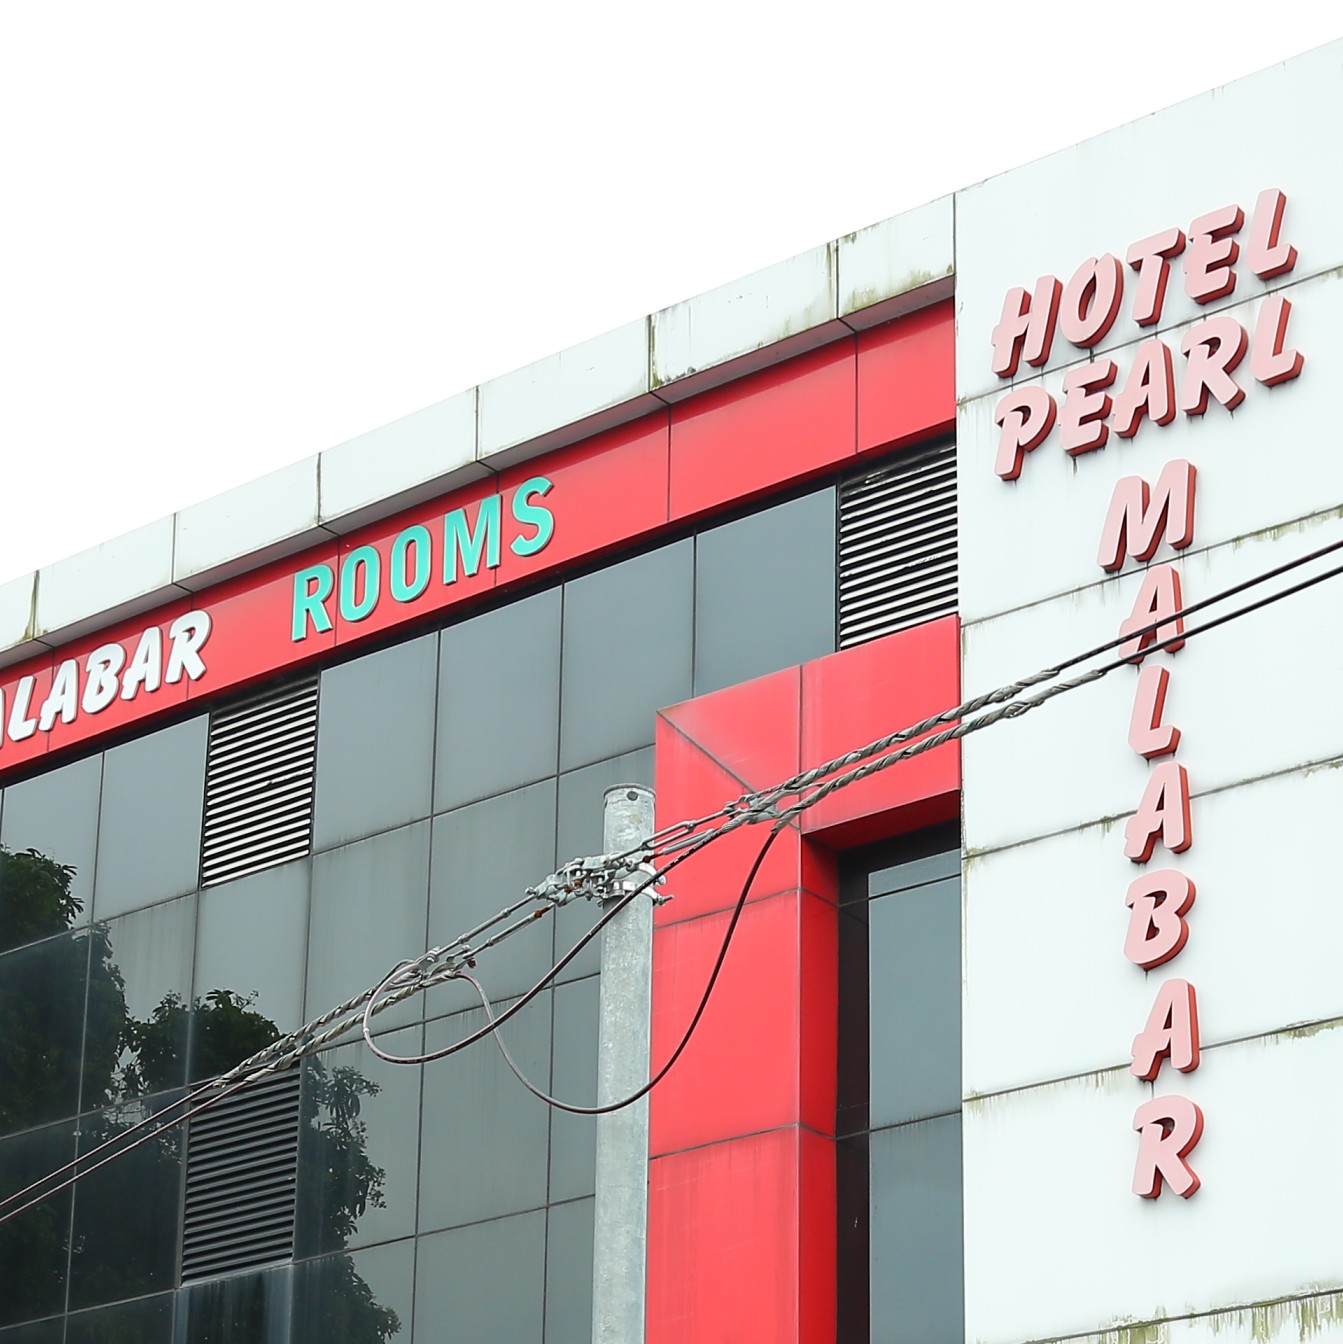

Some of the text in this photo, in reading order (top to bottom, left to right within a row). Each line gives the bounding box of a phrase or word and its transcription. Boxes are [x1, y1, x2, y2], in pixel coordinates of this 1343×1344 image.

[991, 187, 1299, 379] HOTEL
[994, 295, 1305, 481] PEARL
[290, 475, 556, 642] ROOMS
[1097, 459, 1204, 1201] MALABAR
